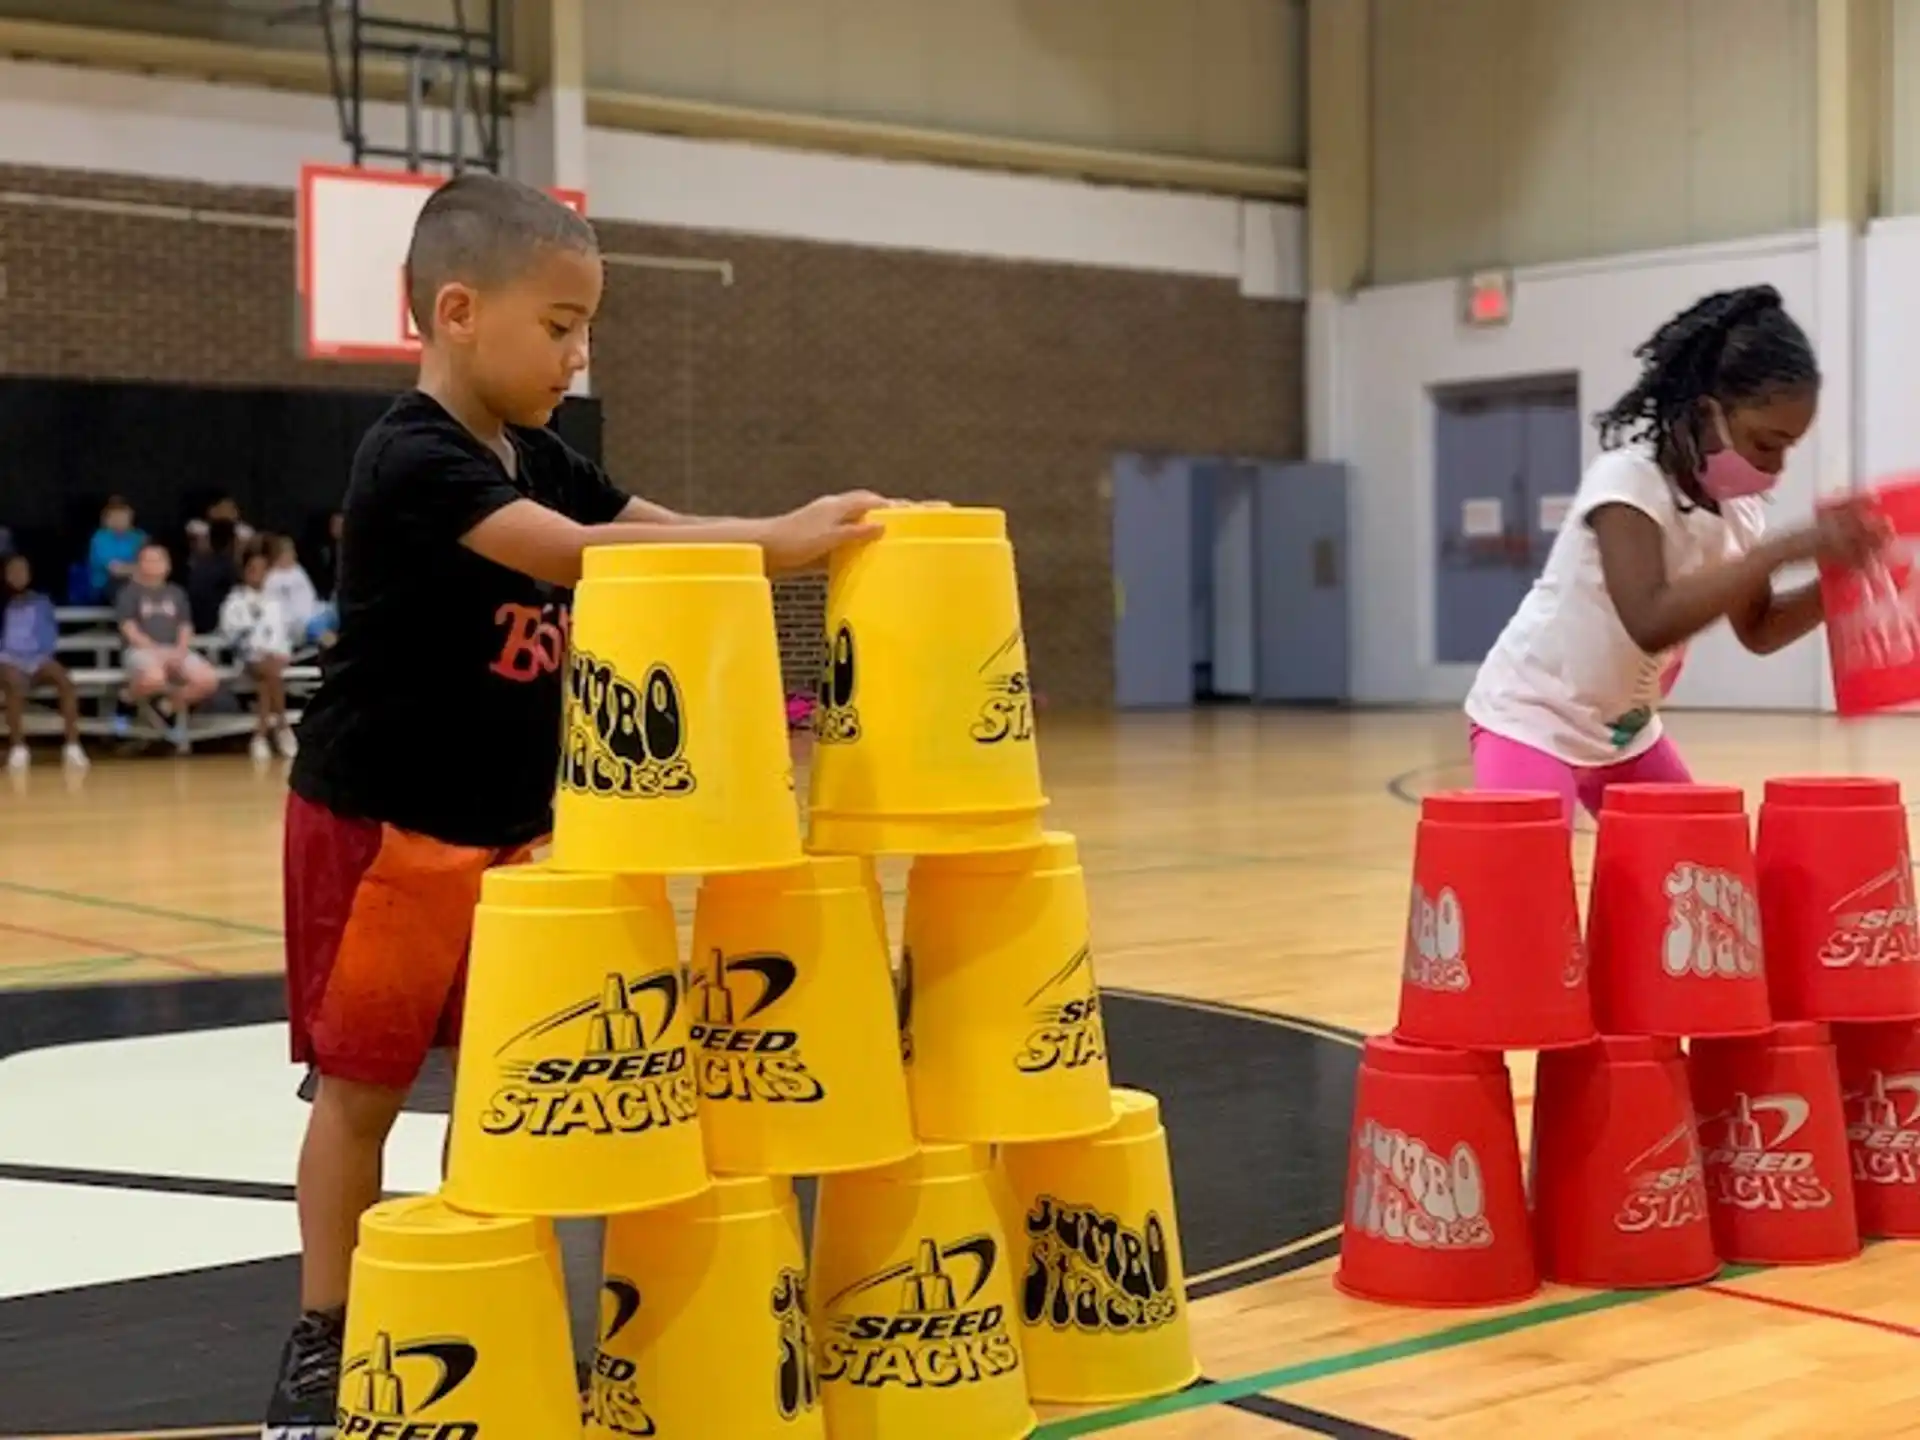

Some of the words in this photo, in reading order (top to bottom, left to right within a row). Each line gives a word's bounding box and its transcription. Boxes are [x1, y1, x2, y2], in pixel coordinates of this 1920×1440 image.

[690, 1029, 797, 1052] PEED
[527, 1046, 686, 1084] SPEED
[479, 1071, 697, 1136] STACKS
[849, 1305, 1003, 1341] SPEED
[818, 1332, 1019, 1388] STACKS
